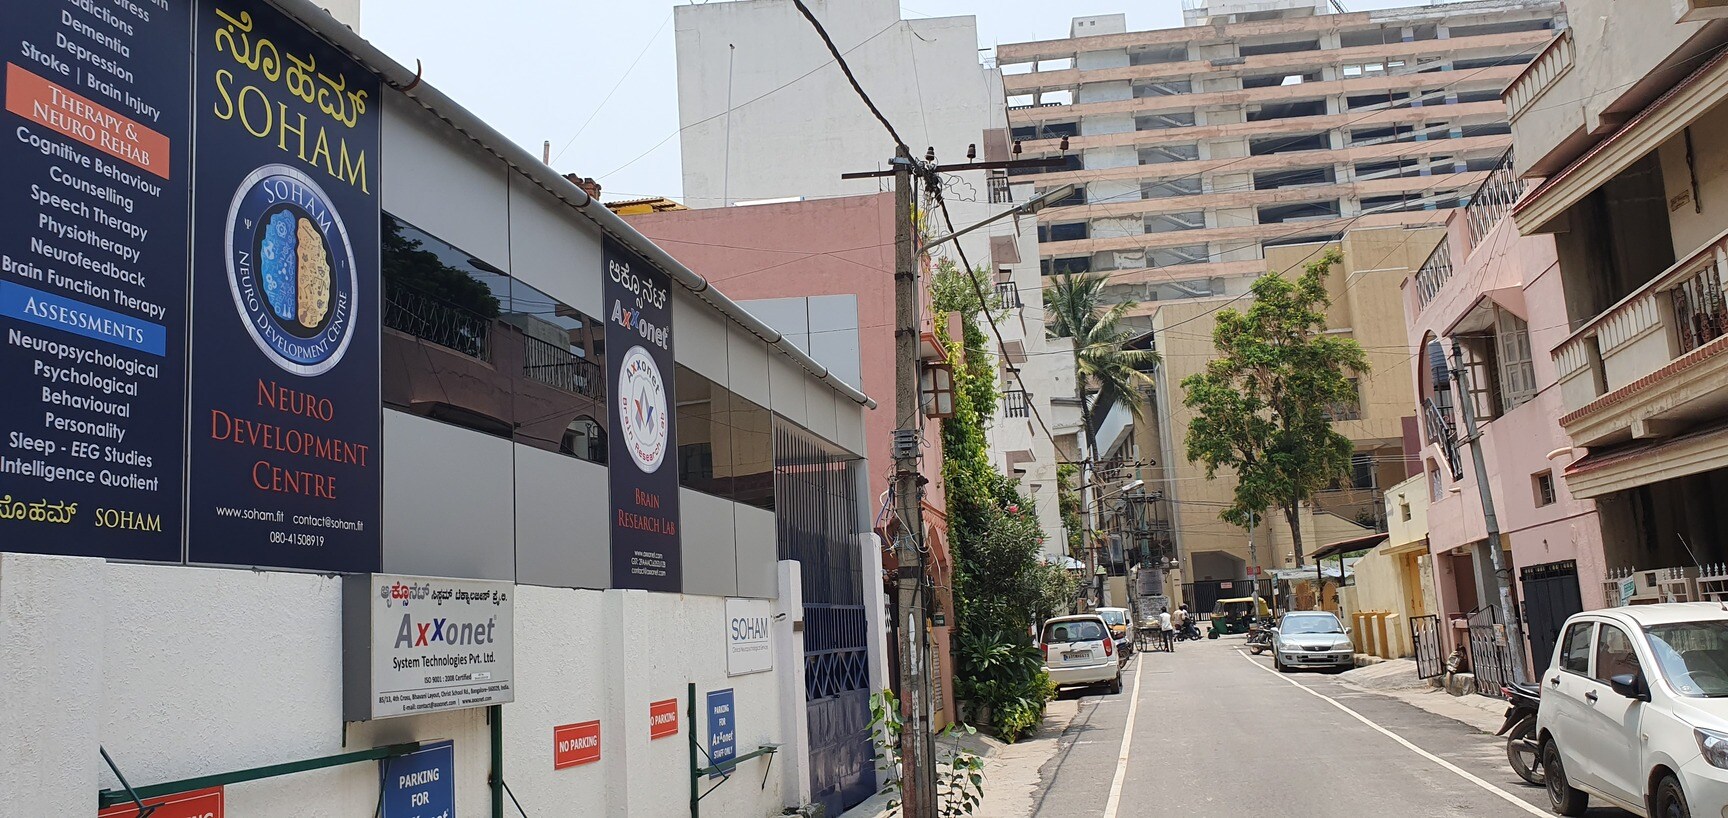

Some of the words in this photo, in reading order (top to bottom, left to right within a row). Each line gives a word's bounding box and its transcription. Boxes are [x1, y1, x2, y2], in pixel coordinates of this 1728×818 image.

[68, 0, 133, 36] dictions
[113, 0, 149, 22] ress
[62, 10, 130, 58] Dementia
[56, 32, 133, 83] Depression
[21, 41, 70, 76] Stroke
[87, 73, 121, 101] Brain
[125, 92, 160, 122] Injury
[48, 85, 123, 134] THERAPY
[125, 123, 139, 143] &
[214, 69, 370, 195] SOHAM
[33, 99, 96, 141] NEURO
[100, 129, 150, 166] REHAB
[16, 126, 91, 168] Cognitive
[95, 157, 161, 198] Behaviour
[50, 166, 133, 213] Counselling
[263, 179, 332, 236] SOHAM
[31, 184, 90, 219] Speech
[93, 206, 148, 242] Therapy
[39, 213, 141, 264] Physiotherapy
[31, 237, 146, 288] Neurofeedback
[2, 255, 43, 281] Brain
[47, 268, 110, 301] Function
[113, 288, 166, 321] Therapy
[239, 251, 259, 312] NEURO
[257, 312, 329, 359] DEVELOPMENT
[327, 291, 347, 342] CENTRE
[23, 296, 144, 344] ASSESSMENTS
[8, 328, 159, 379] Neuropsychological
[34, 359, 138, 397] Psychological
[42, 386, 130, 418] Behavioural
[257, 378, 334, 421] NEURO
[45, 412, 126, 443] Personality
[211, 409, 368, 467] DEVELOPMENT
[9, 431, 56, 456] Sleep
[71, 441, 100, 460] EEG
[104, 446, 153, 468] Studies
[634, 442, 661, 462] Research
[0, 456, 96, 482] Intelligence
[99, 469, 159, 492] Quotient
[253, 460, 336, 499] CENTRE
[635, 488, 660, 509] BRAIN
[95, 508, 162, 532] SOHAM
[215, 506, 285, 523] www.soham.fit
[292, 513, 364, 531] contact@soham.fit
[618, 509, 660, 533] RESEARCH
[662, 517, 676, 536] LAB
[269, 531, 325, 547] 080-41508919
[731, 617, 768, 640] SOHAM
[393, 656, 420, 671] System
[421, 654, 468, 668] Technologies
[468, 653, 482, 665] Pvt.
[483, 651, 496, 664] Ltd.
[424, 676, 432, 684] ISO
[455, 673, 472, 681] Certified
[655, 712, 676, 725] PARKING
[714, 704, 729, 714] PARKING
[718, 717, 726, 727] FOR
[559, 741, 569, 753] NO
[570, 735, 598, 751] PARKING
[713, 748, 724, 759] STAFF
[724, 746, 733, 756] ONLY
[399, 768, 440, 789] PARKING
[411, 791, 430, 807] FOR
